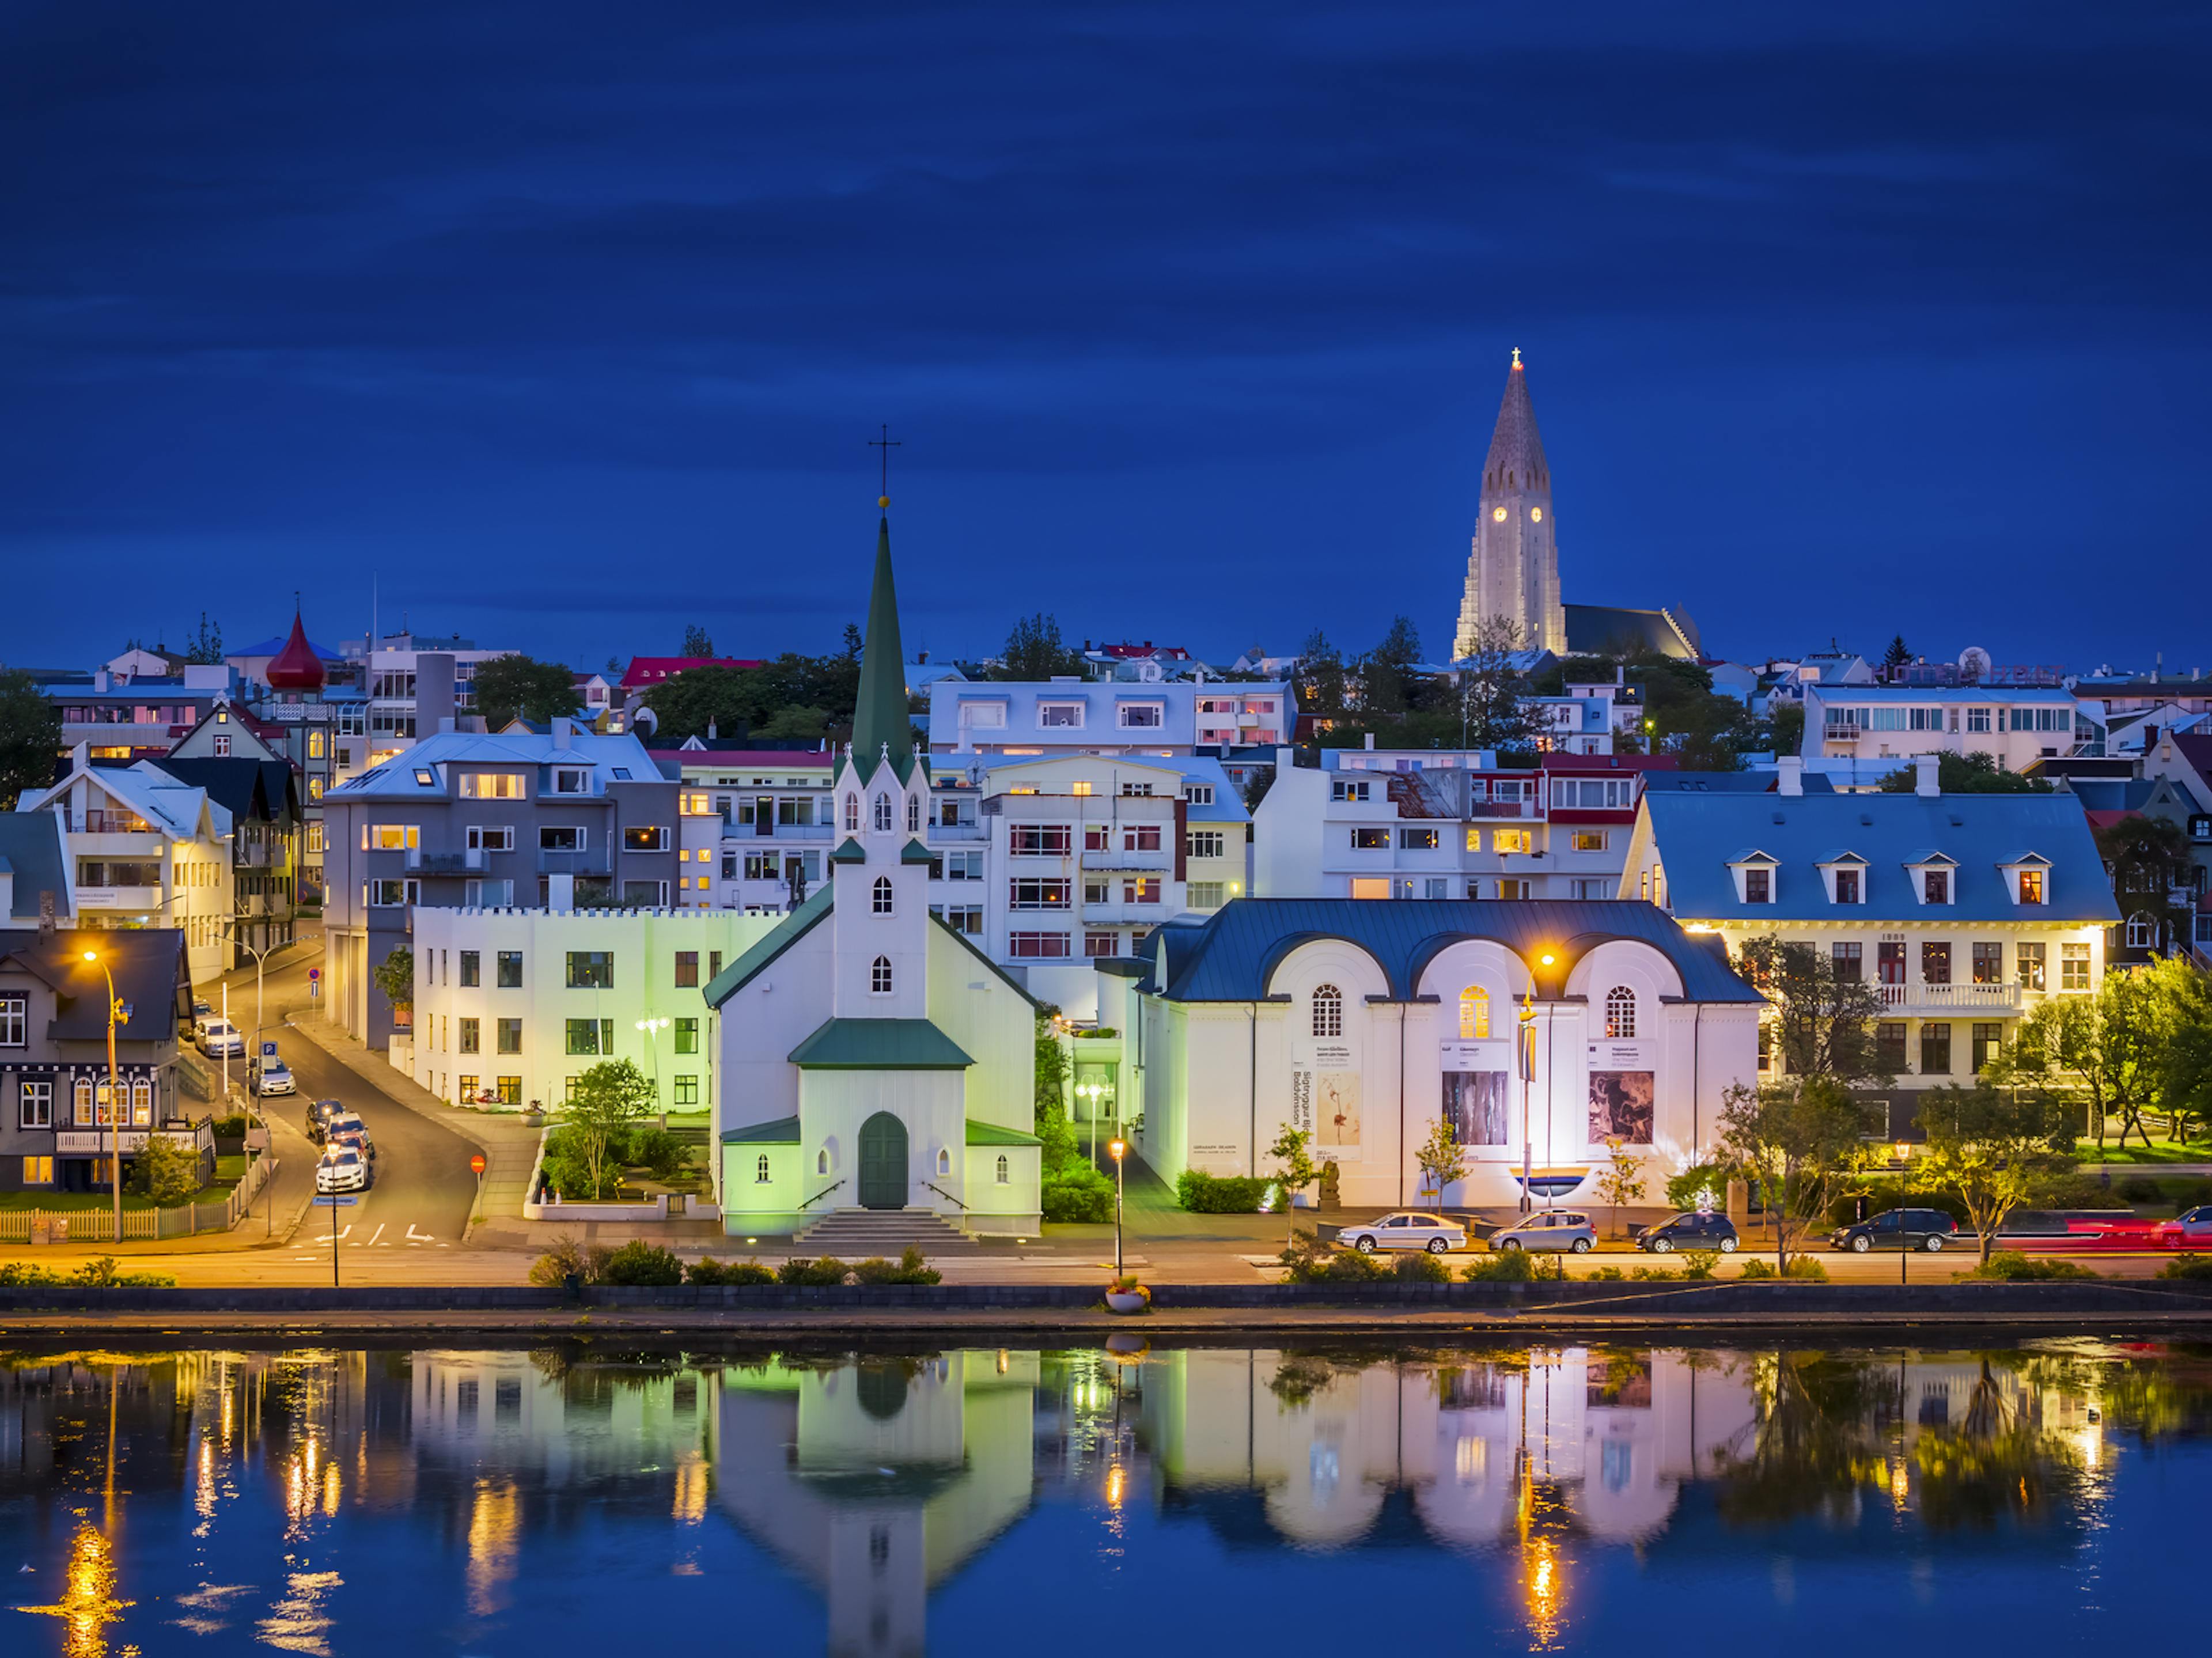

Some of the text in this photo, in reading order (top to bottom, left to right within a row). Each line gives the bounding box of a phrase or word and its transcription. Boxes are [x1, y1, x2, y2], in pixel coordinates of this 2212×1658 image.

[1990, 664, 2066, 684] HOLT
[1883, 933, 1905, 941] 1909
[266, 1044, 273, 1054] P
[1293, 1071, 1301, 1125] Baldvinsson
[1302, 1071, 1312, 1145] Sigtryggur Bji
